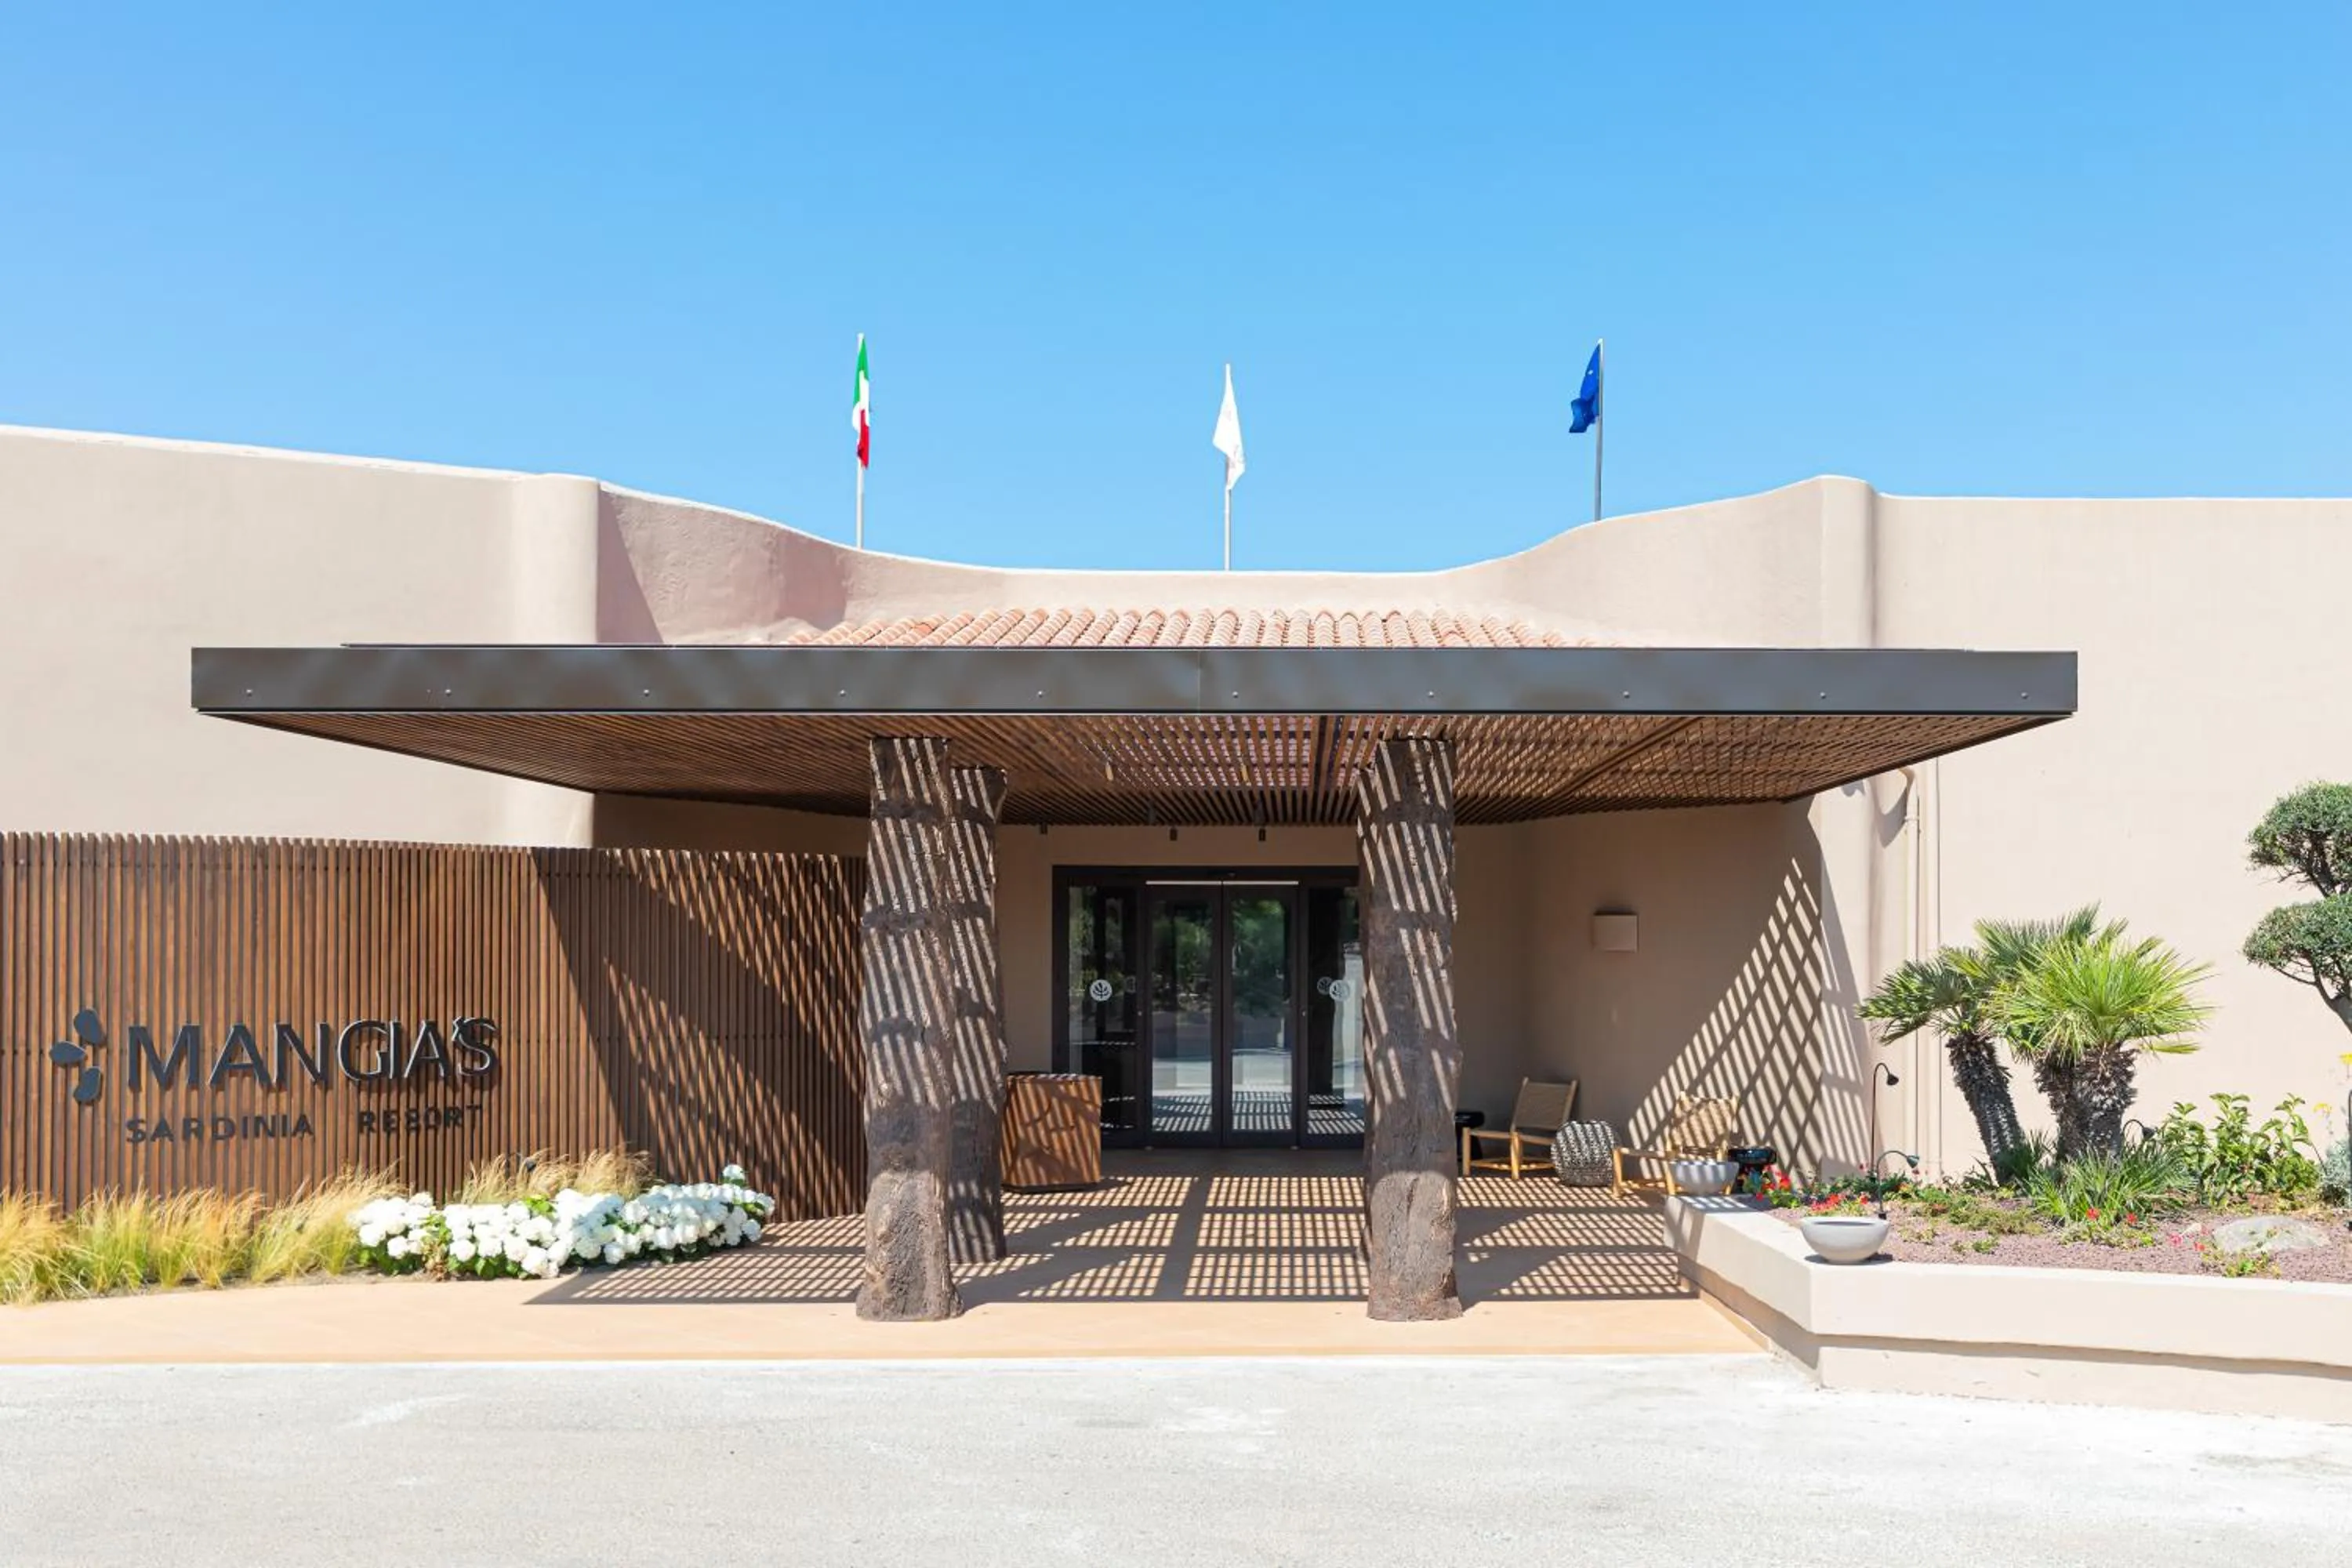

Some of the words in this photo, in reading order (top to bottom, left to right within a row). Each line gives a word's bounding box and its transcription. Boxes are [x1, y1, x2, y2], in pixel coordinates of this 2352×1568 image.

[127, 1016, 498, 1088] MANGIA'S
[126, 1112, 314, 1143] SARDINIA
[358, 1103, 483, 1134] RESORT
